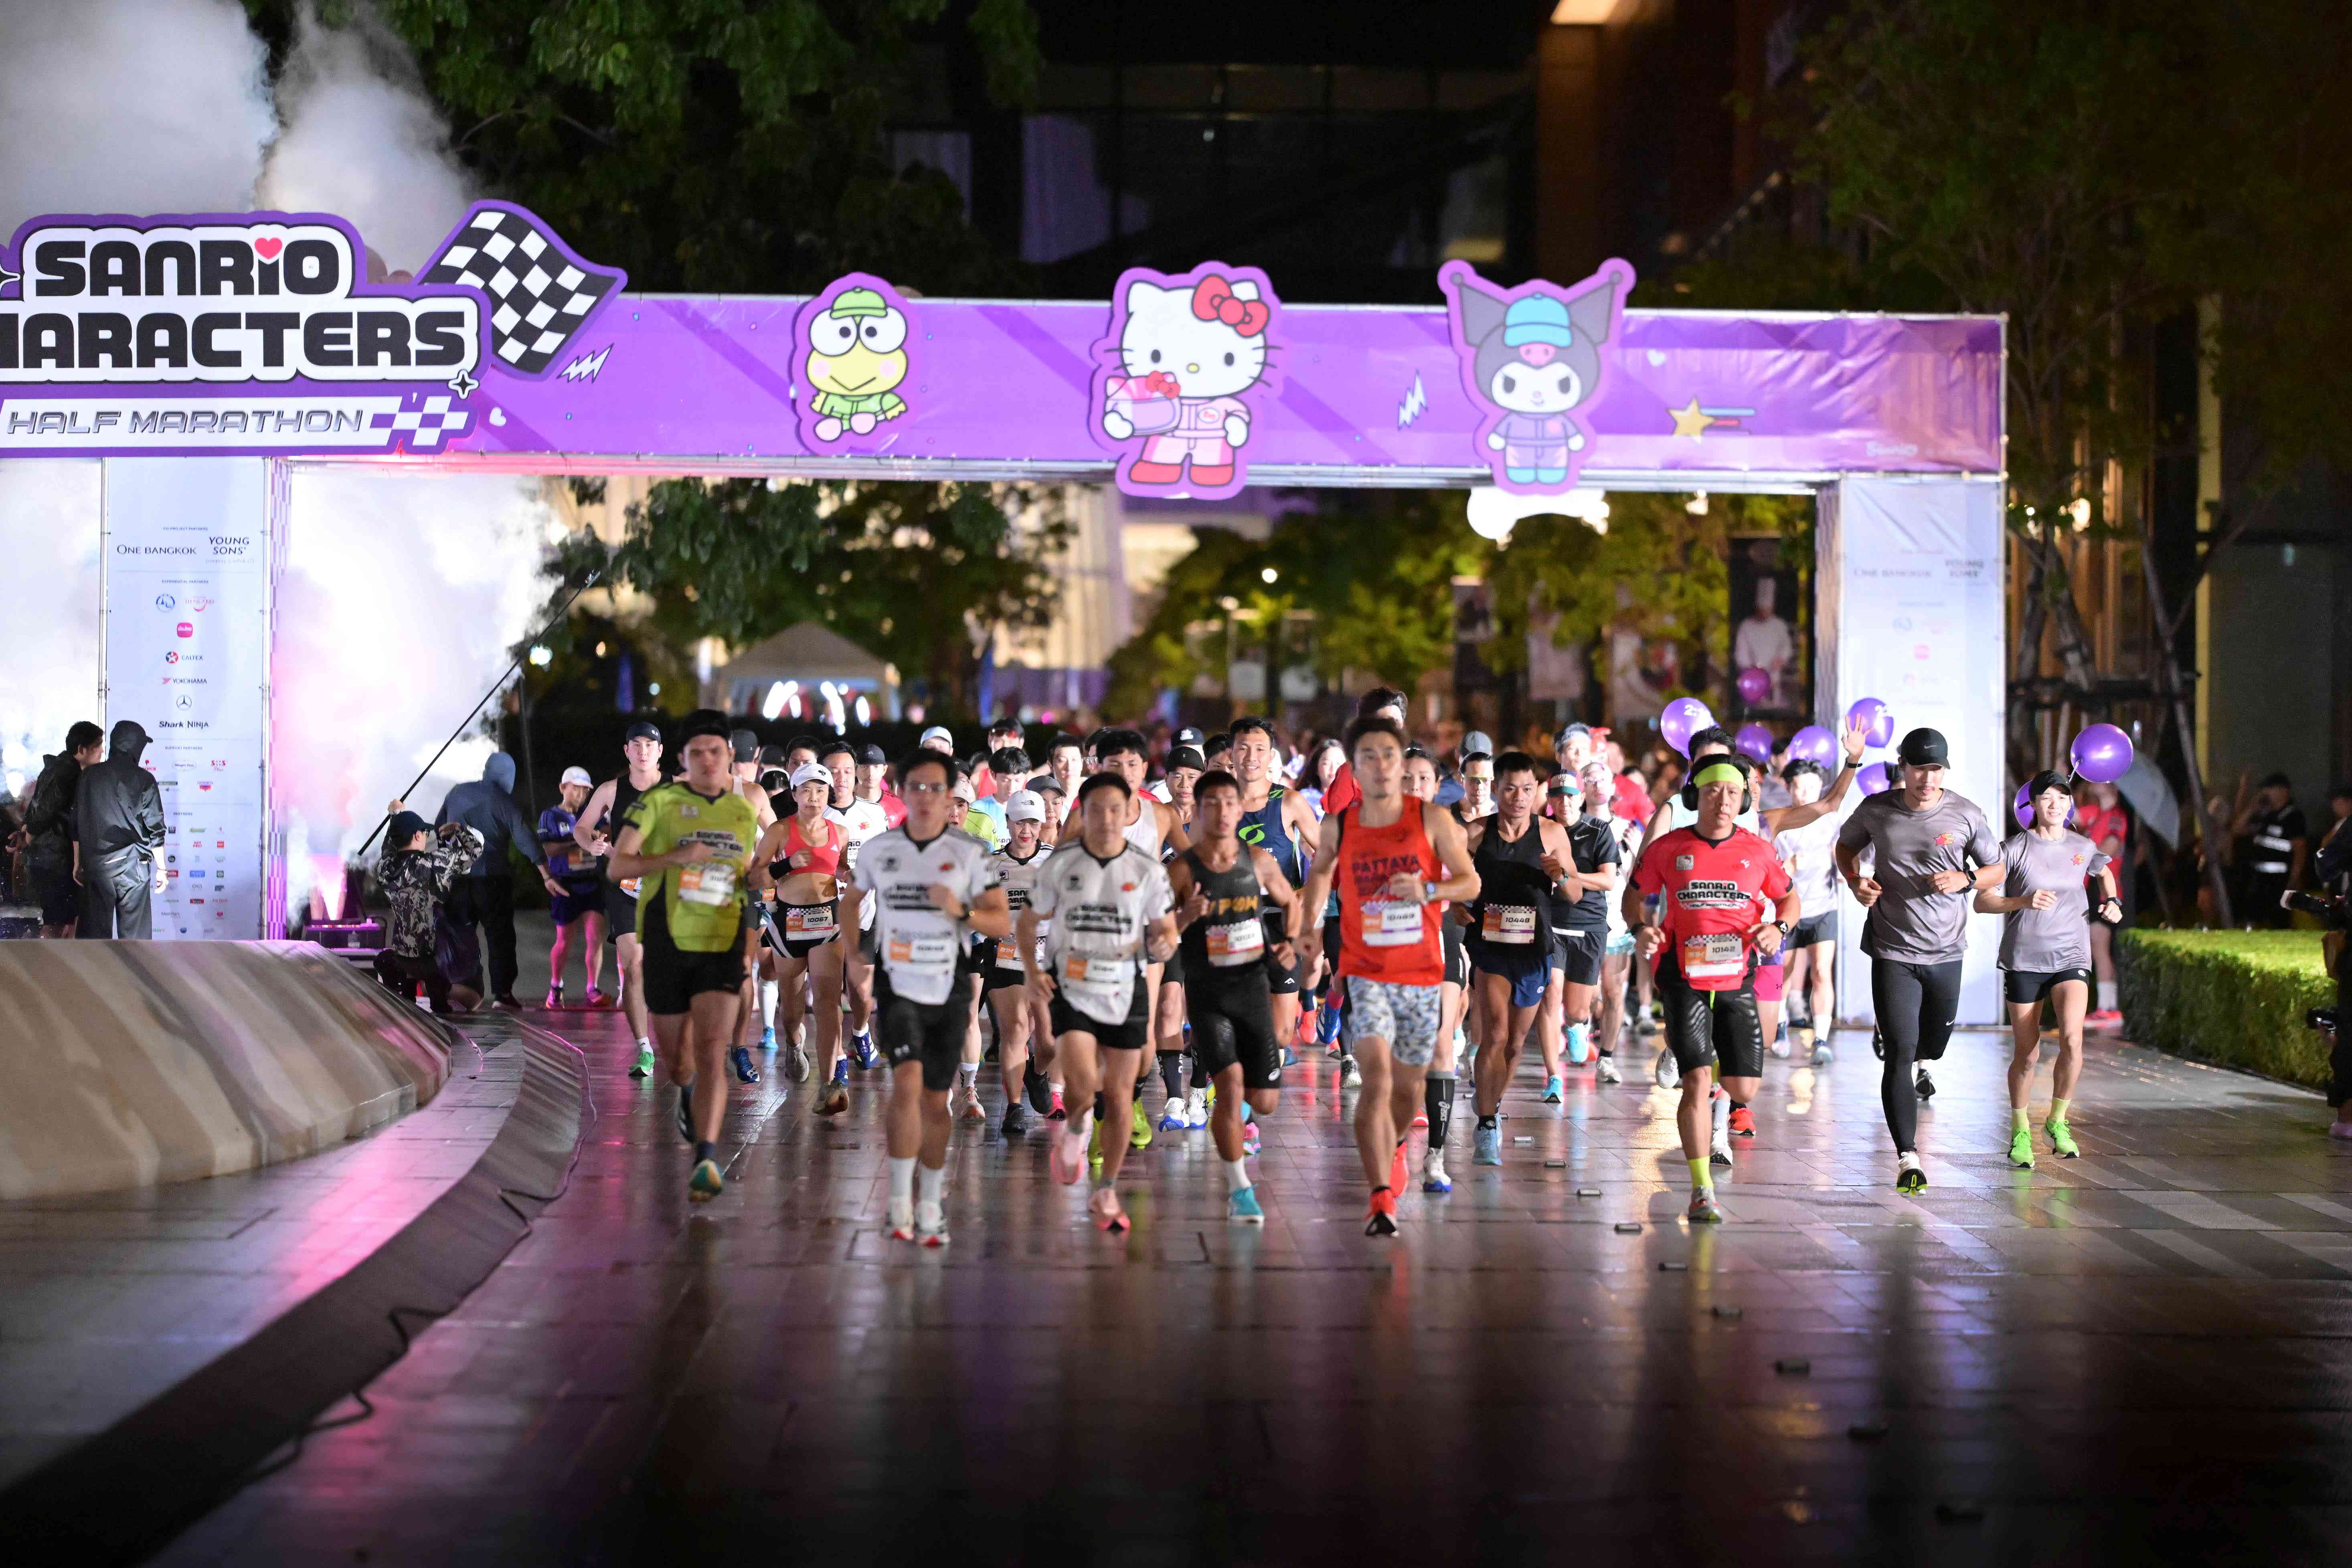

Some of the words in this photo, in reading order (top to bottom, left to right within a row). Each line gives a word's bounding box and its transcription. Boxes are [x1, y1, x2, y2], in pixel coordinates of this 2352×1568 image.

[7, 411, 122, 434] HALF
[128, 410, 363, 433] MARATHON
[209, 536, 249, 545] YOUNG
[117, 544, 141, 554] ONE
[187, 720, 208, 729] NINJA
